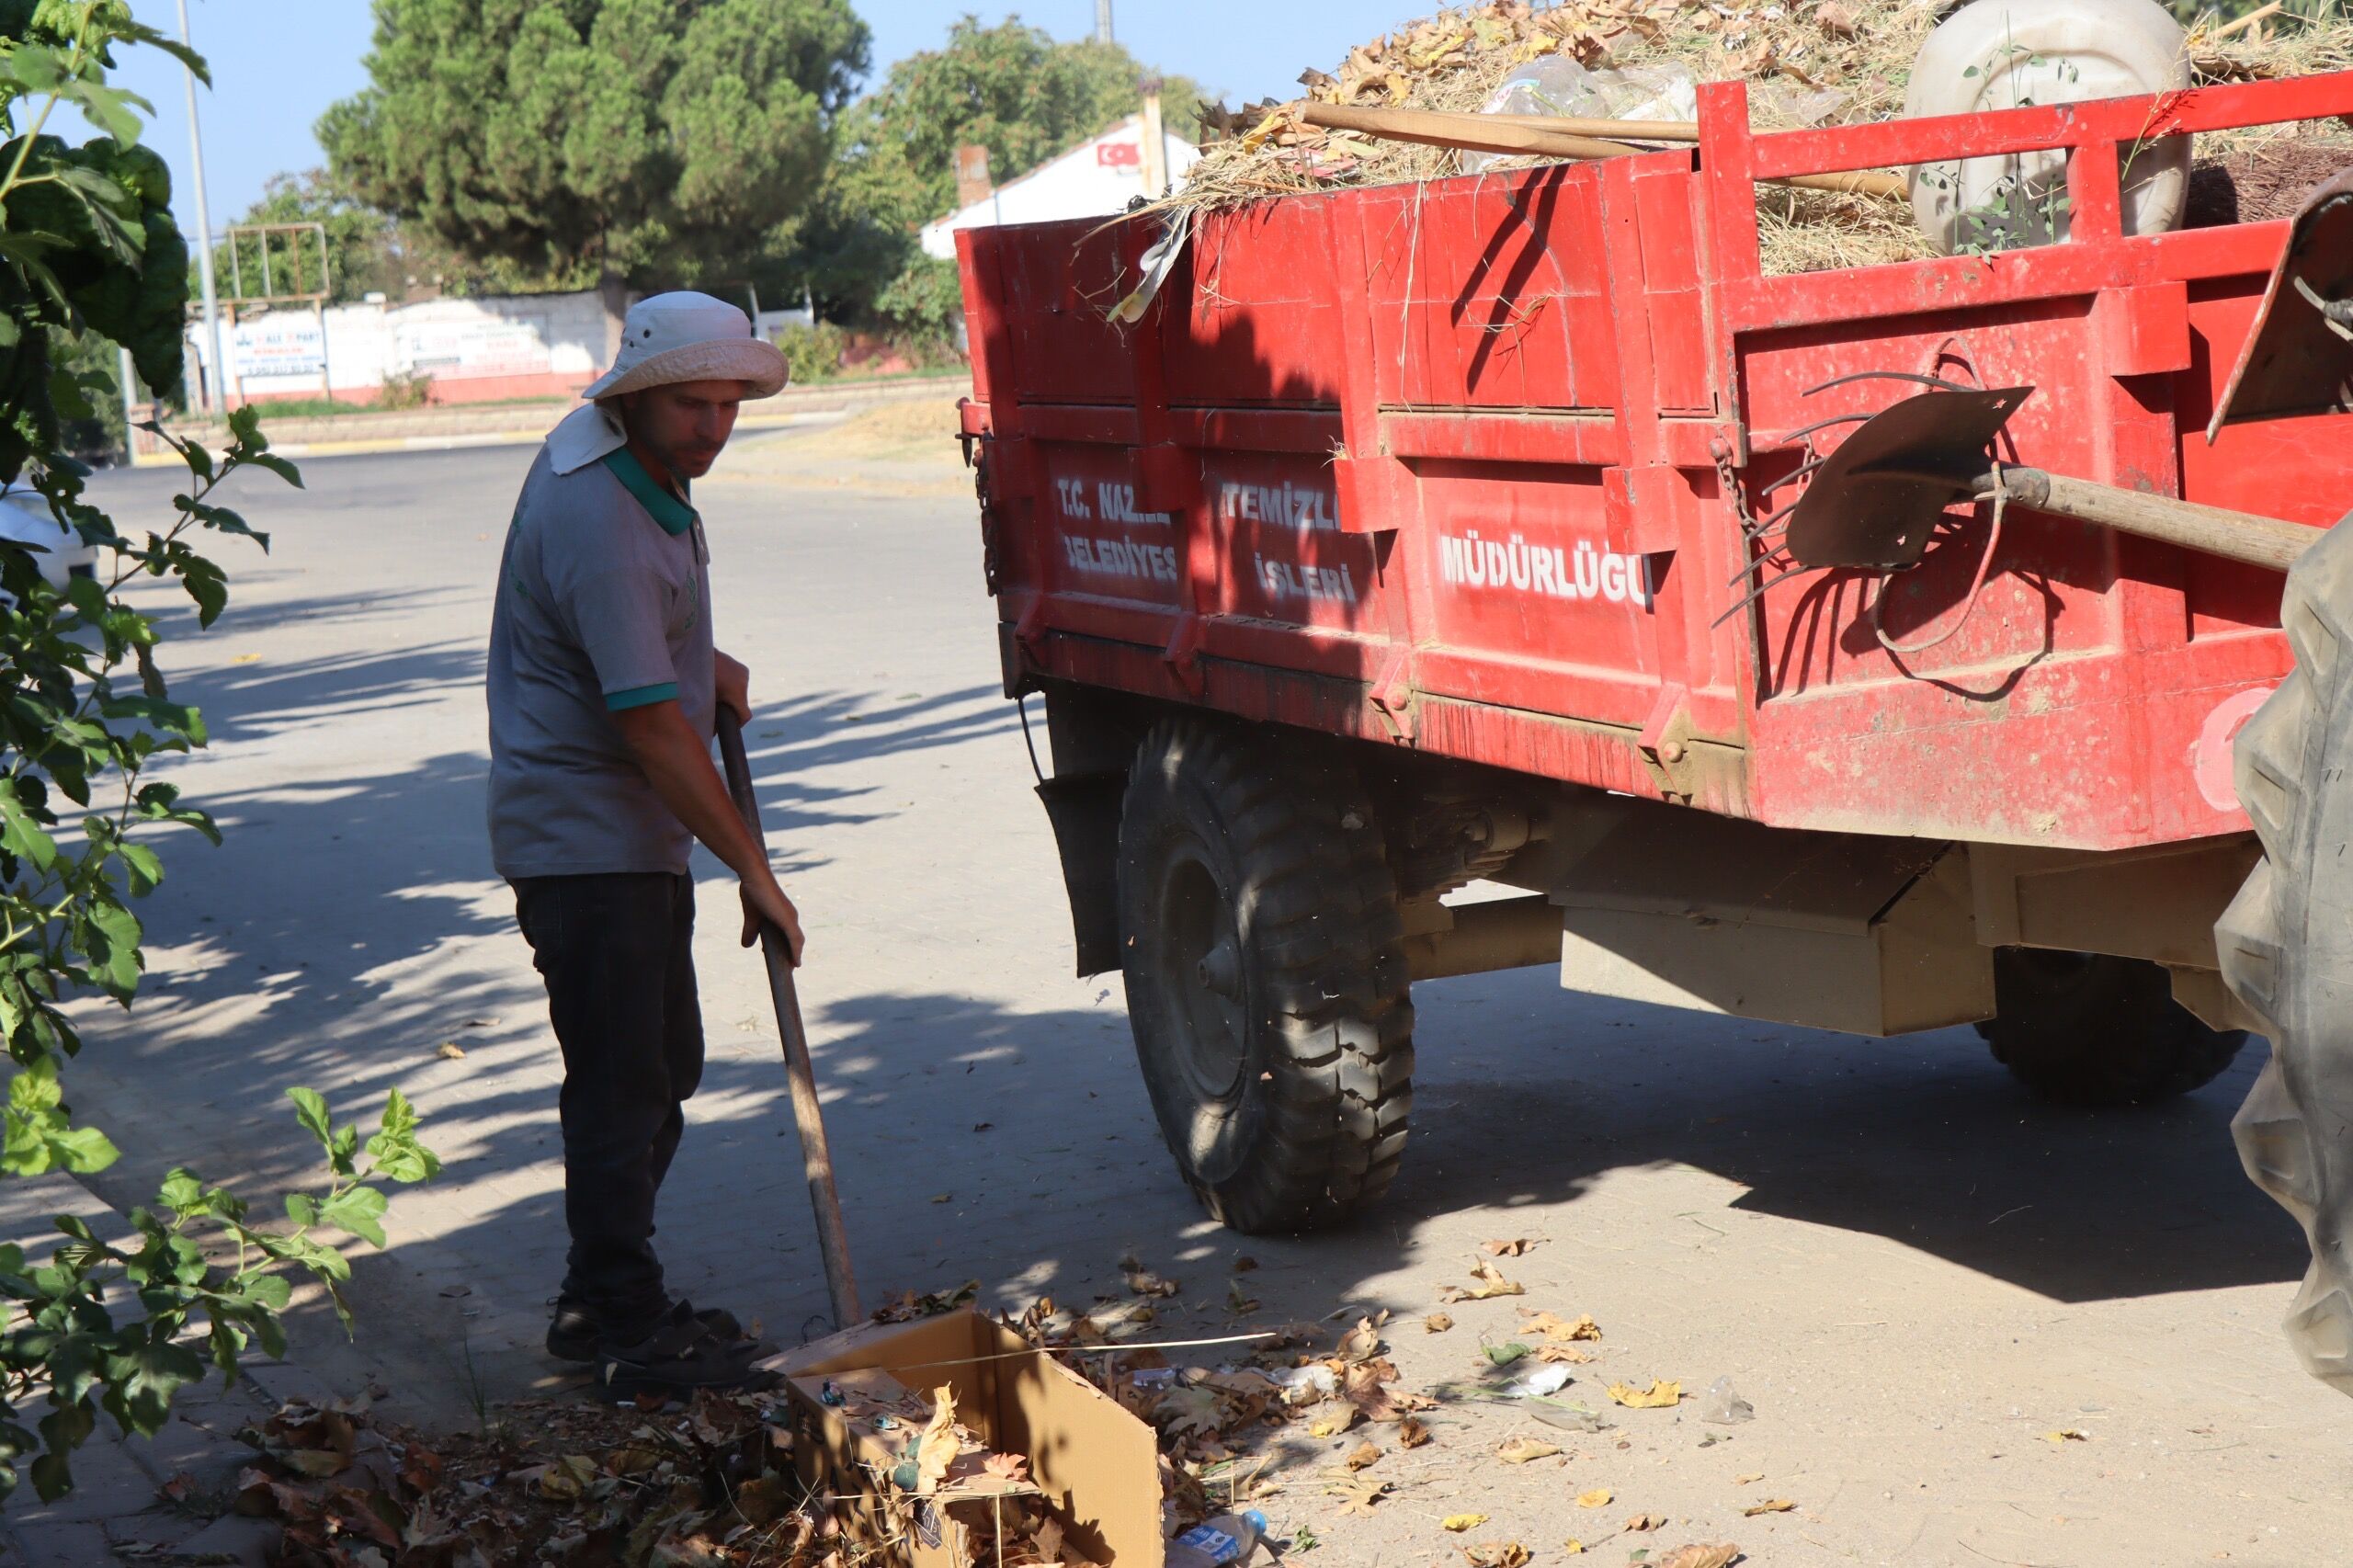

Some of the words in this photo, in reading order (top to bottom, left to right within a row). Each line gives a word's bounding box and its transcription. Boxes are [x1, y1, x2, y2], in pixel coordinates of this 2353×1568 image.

[1058, 479, 1090, 518] T.C.
[1222, 481, 1342, 530] TEMİZL
[1063, 534, 1177, 581] BELEDİYES
